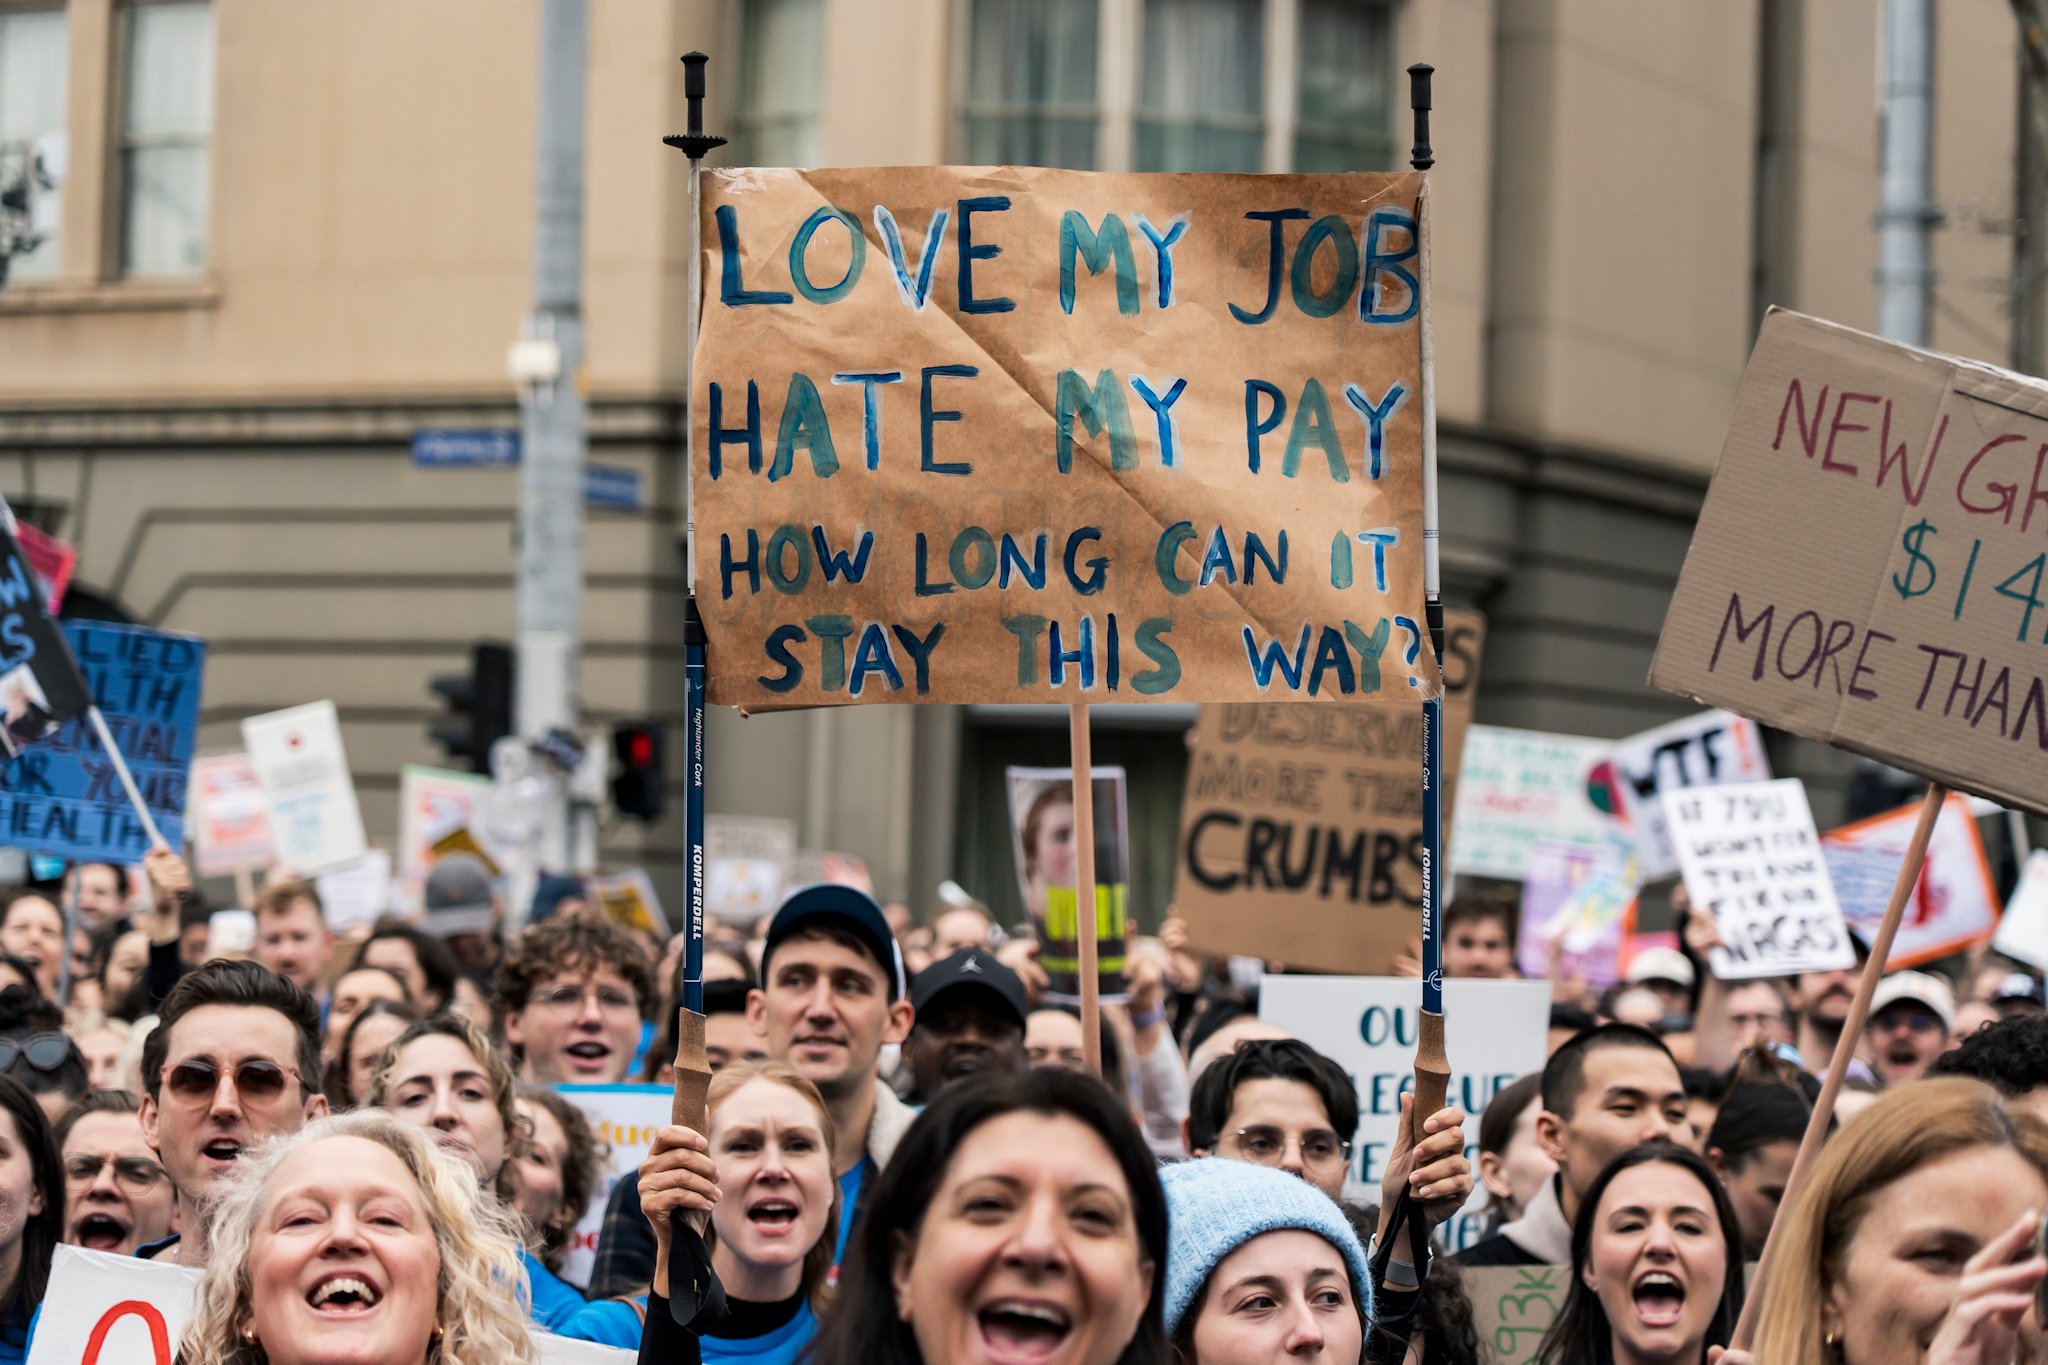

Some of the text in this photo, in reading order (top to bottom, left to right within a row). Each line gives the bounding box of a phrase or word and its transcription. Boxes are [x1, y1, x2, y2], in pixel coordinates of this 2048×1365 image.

[715, 196, 1420, 326] LOVE MY JOB
[708, 364, 1412, 484] HATE MY PAY
[1772, 378, 1949, 508] NEW
[720, 519, 1400, 600] HOW LONG CAN IT
[1893, 519, 2048, 646] $14
[79, 628, 196, 674] LIED
[757, 613, 1422, 699] STAY THIS WAY?
[1708, 593, 1897, 702] MORE
[693, 707, 704, 788] Highlander Cork
[1195, 751, 1328, 813] MORE
[1422, 767, 1431, 790] Cork
[692, 844, 704, 940] KOMPERDELL
[1186, 808, 1426, 910] CRUMBS
[1422, 847, 1431, 941] KOMPERDELL
